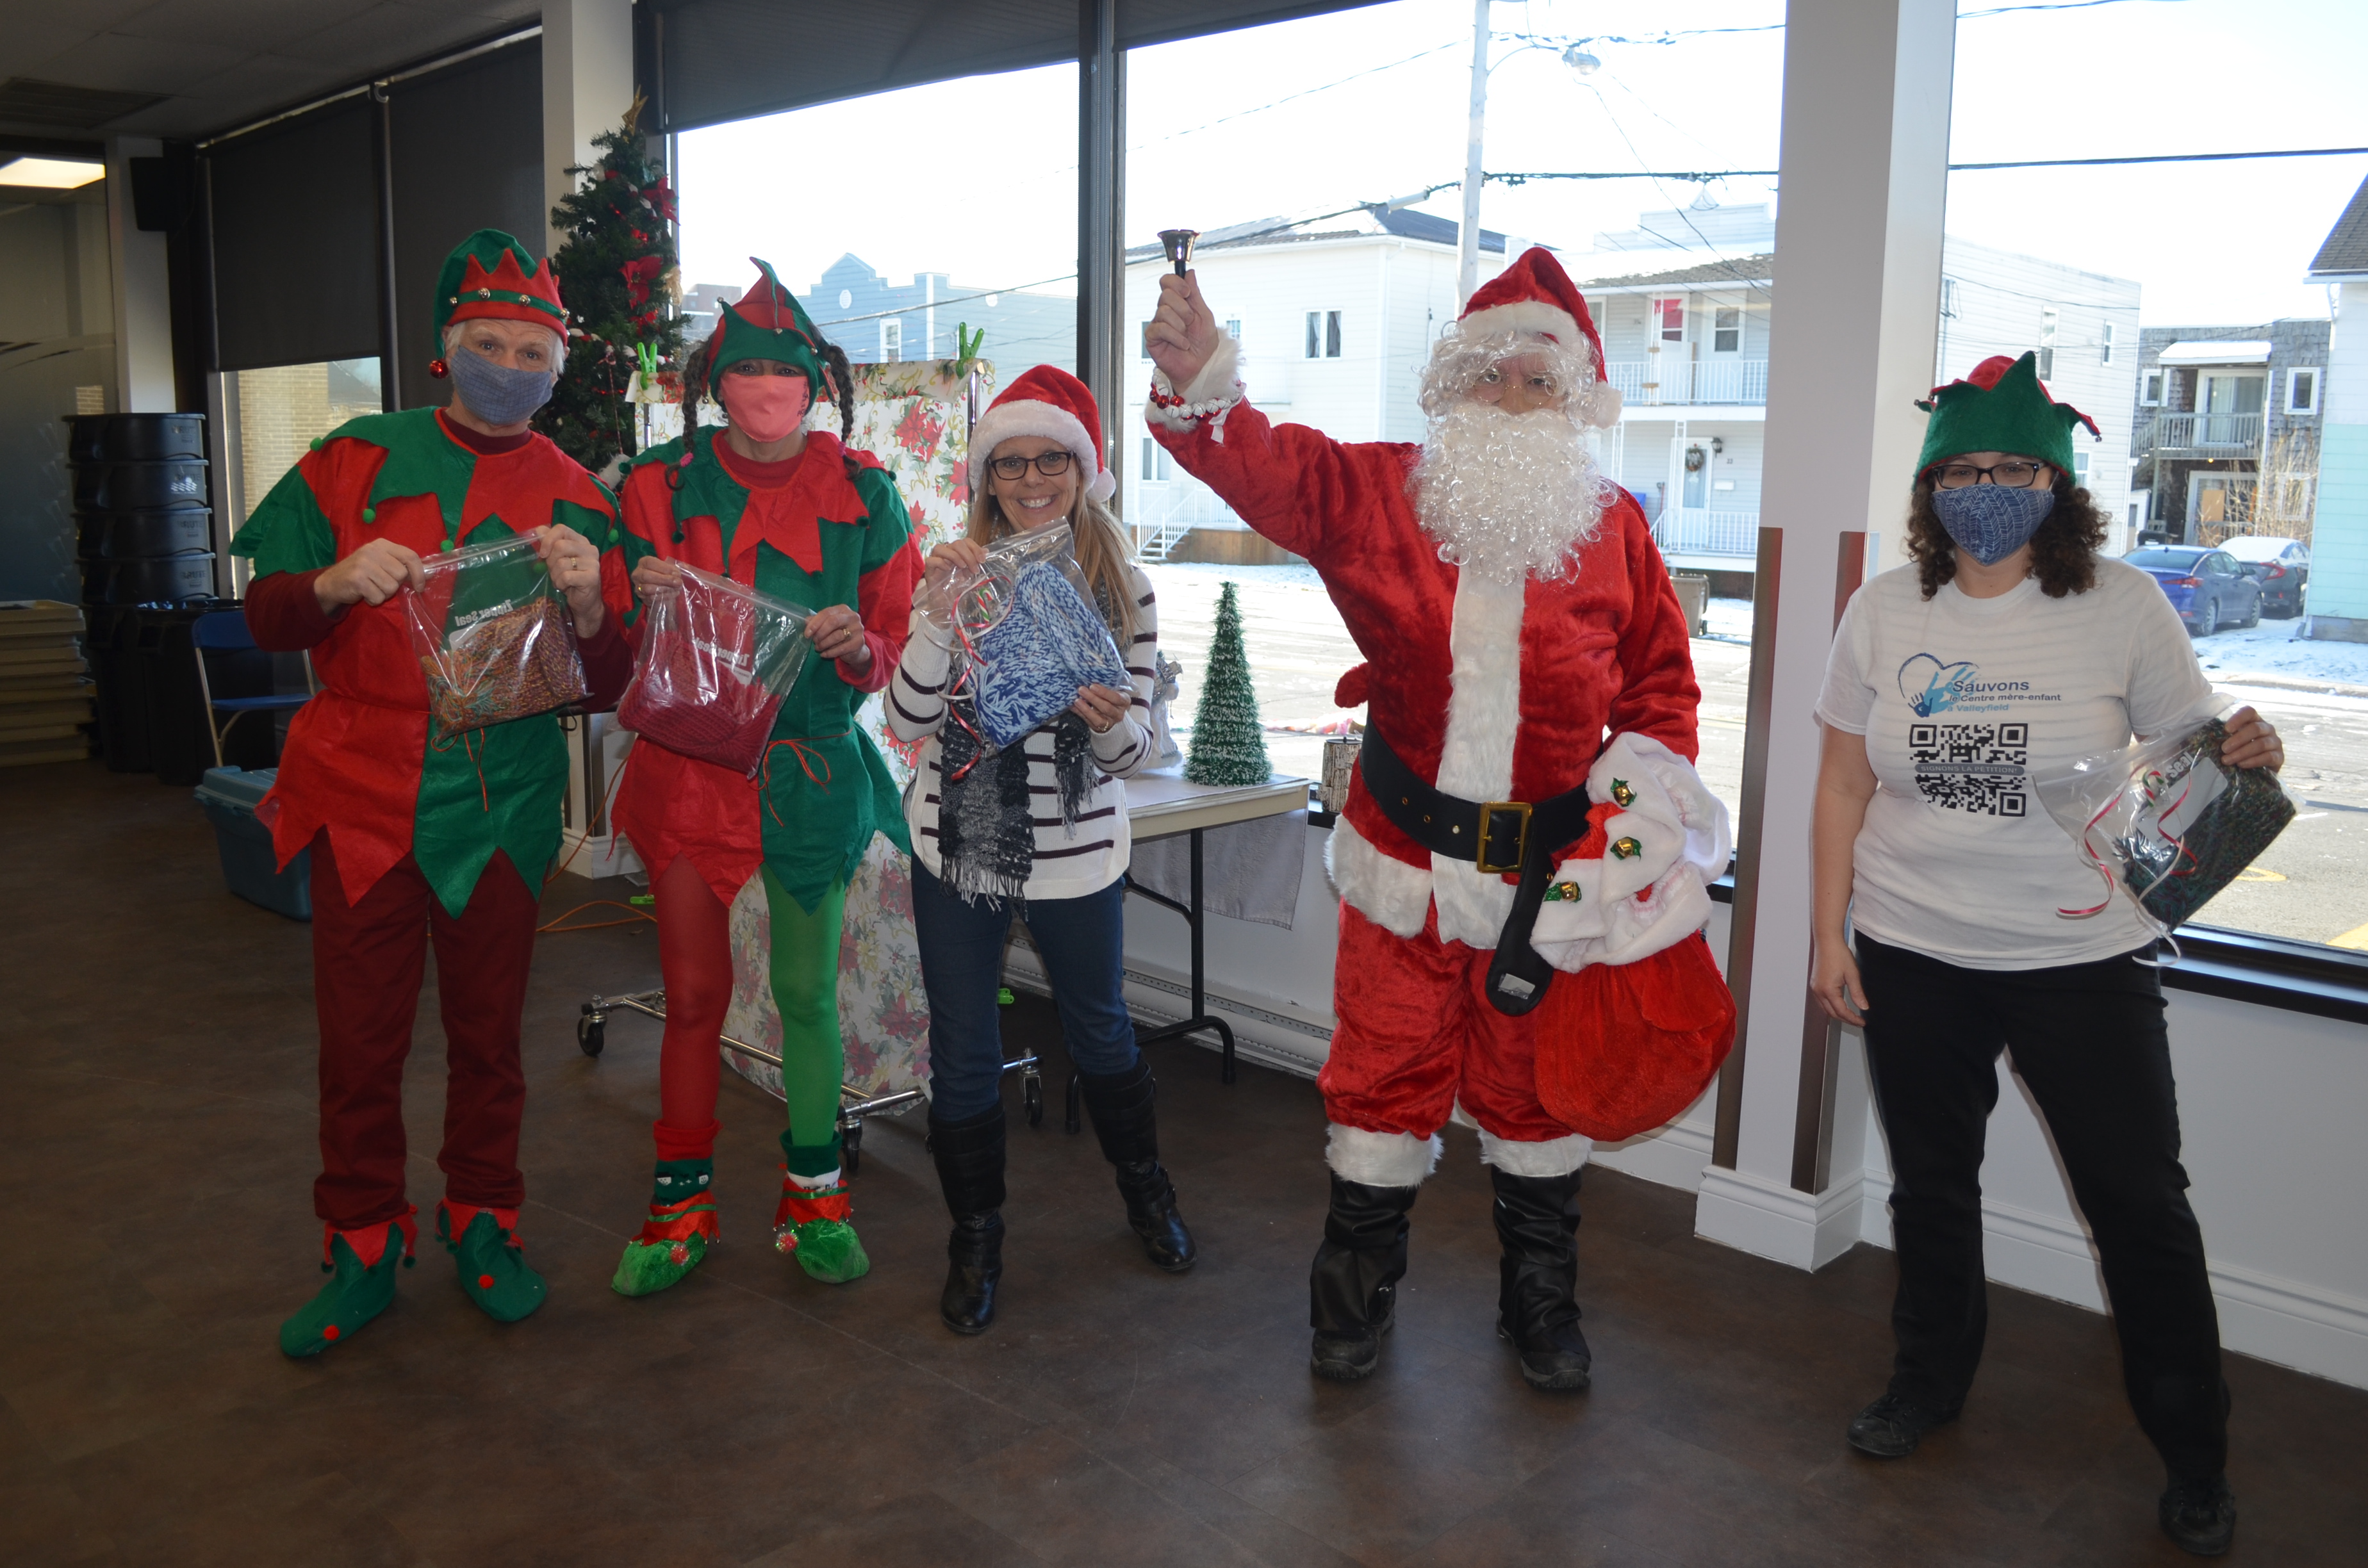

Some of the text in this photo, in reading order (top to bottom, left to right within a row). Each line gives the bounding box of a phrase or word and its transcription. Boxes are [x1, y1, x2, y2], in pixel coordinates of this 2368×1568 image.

[1952, 680, 2030, 692] Sauvons
[1957, 703, 2010, 713] Valleyfield
[2165, 751, 2194, 778] Seal
